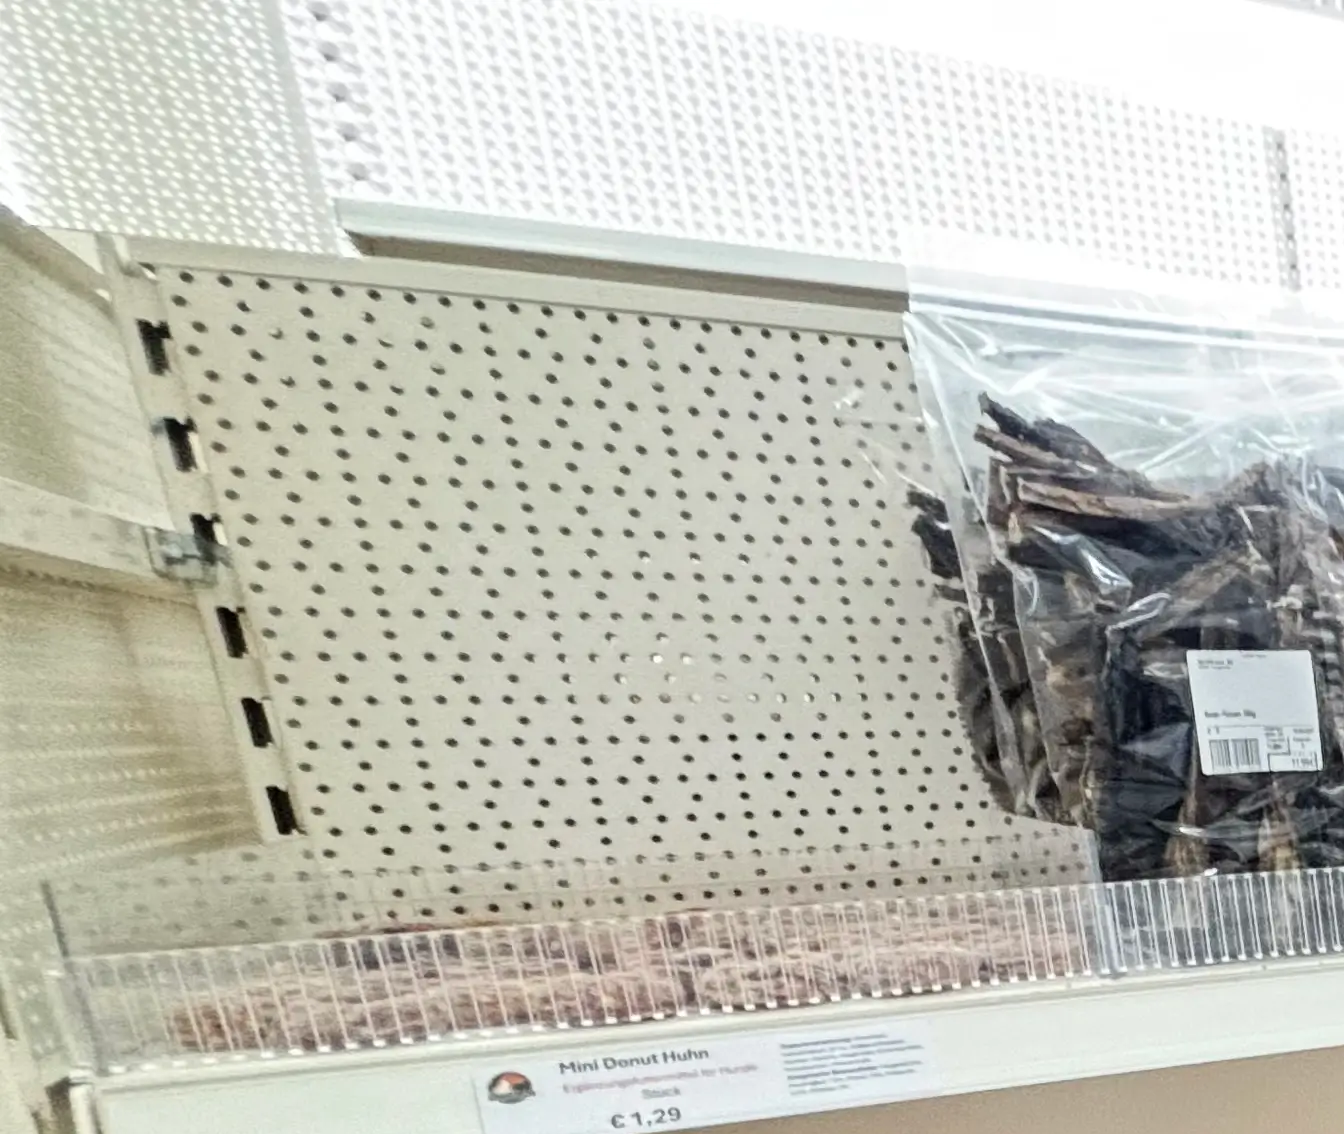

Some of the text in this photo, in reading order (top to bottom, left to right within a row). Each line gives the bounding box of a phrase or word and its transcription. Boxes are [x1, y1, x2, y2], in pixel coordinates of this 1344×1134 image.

[558, 1048, 710, 1075] Mini Donut Huhn
[610, 1107, 682, 1129] € 1,29
